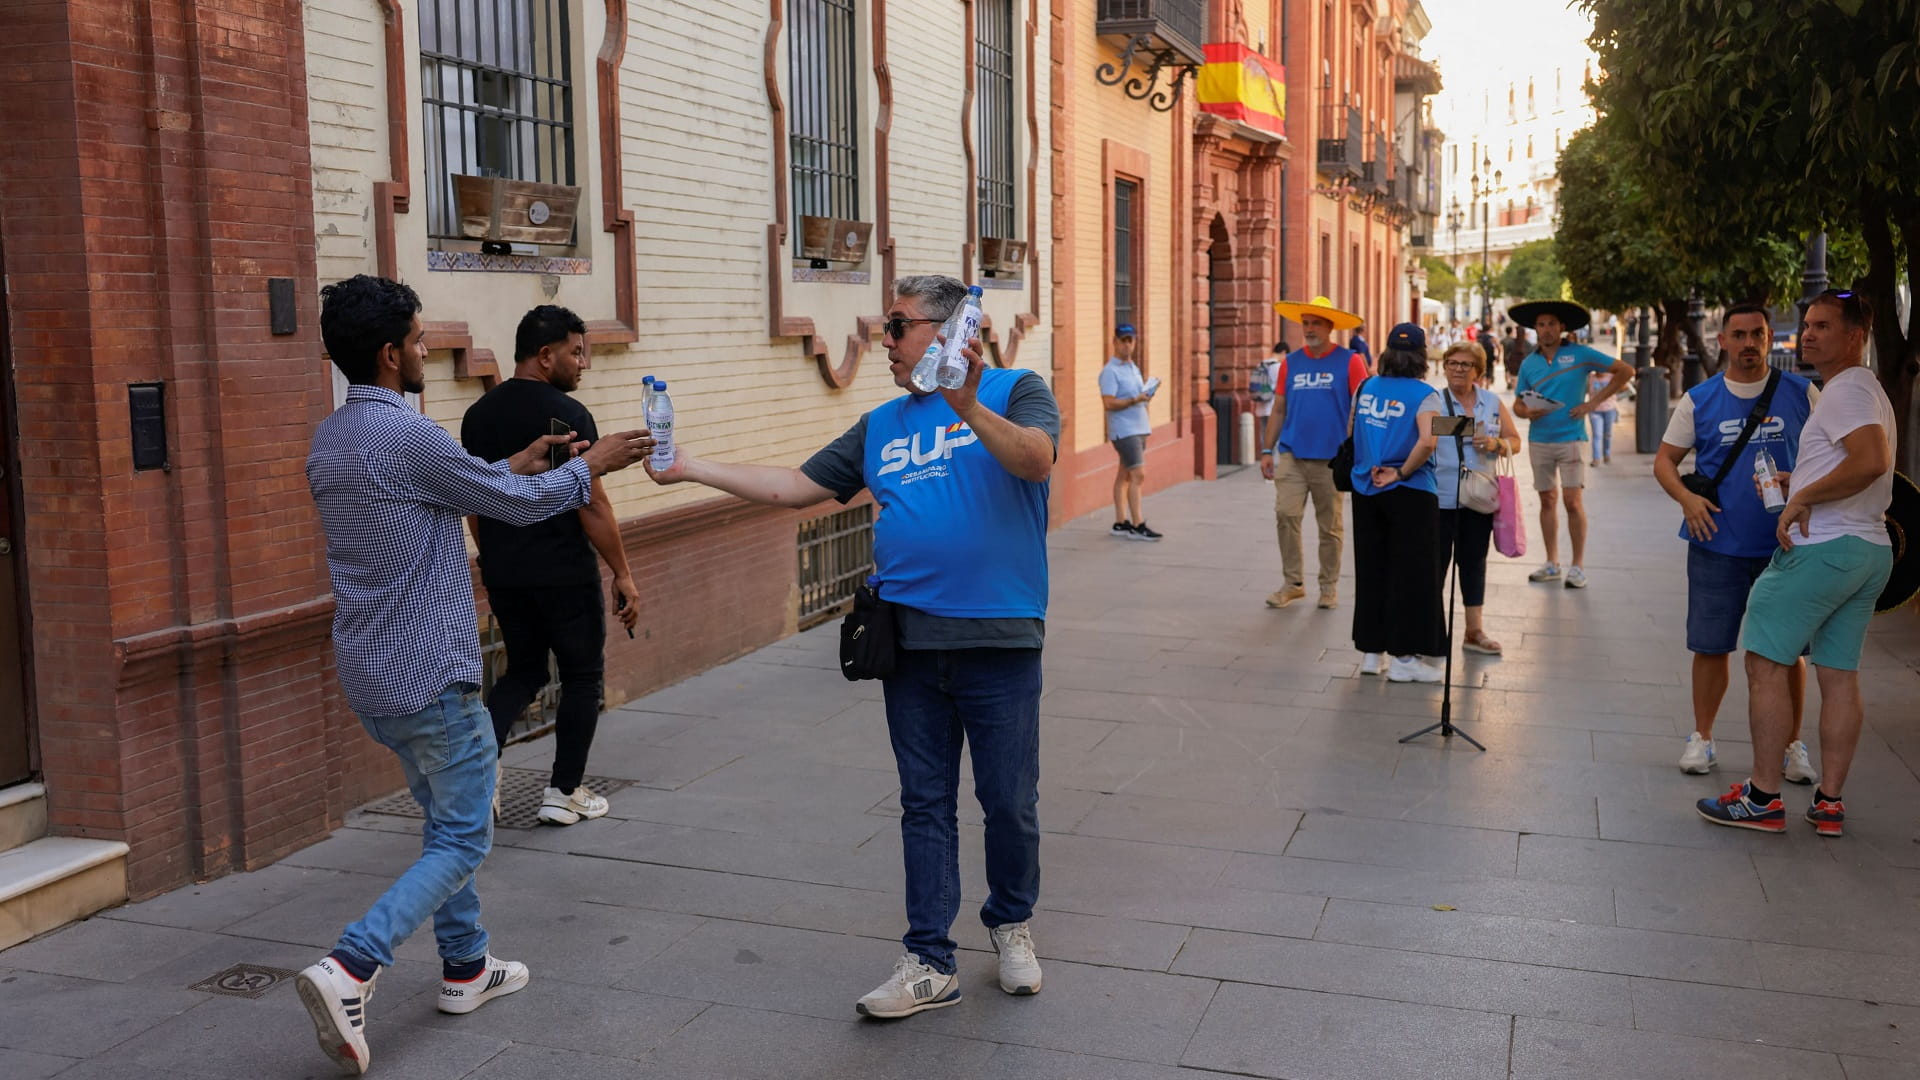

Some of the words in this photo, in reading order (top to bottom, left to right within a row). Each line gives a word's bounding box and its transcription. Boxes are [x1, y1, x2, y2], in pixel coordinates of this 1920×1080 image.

[1293, 373, 1334, 388] SUP
[1358, 394, 1406, 420] SUP
[877, 420, 978, 477] SUP
